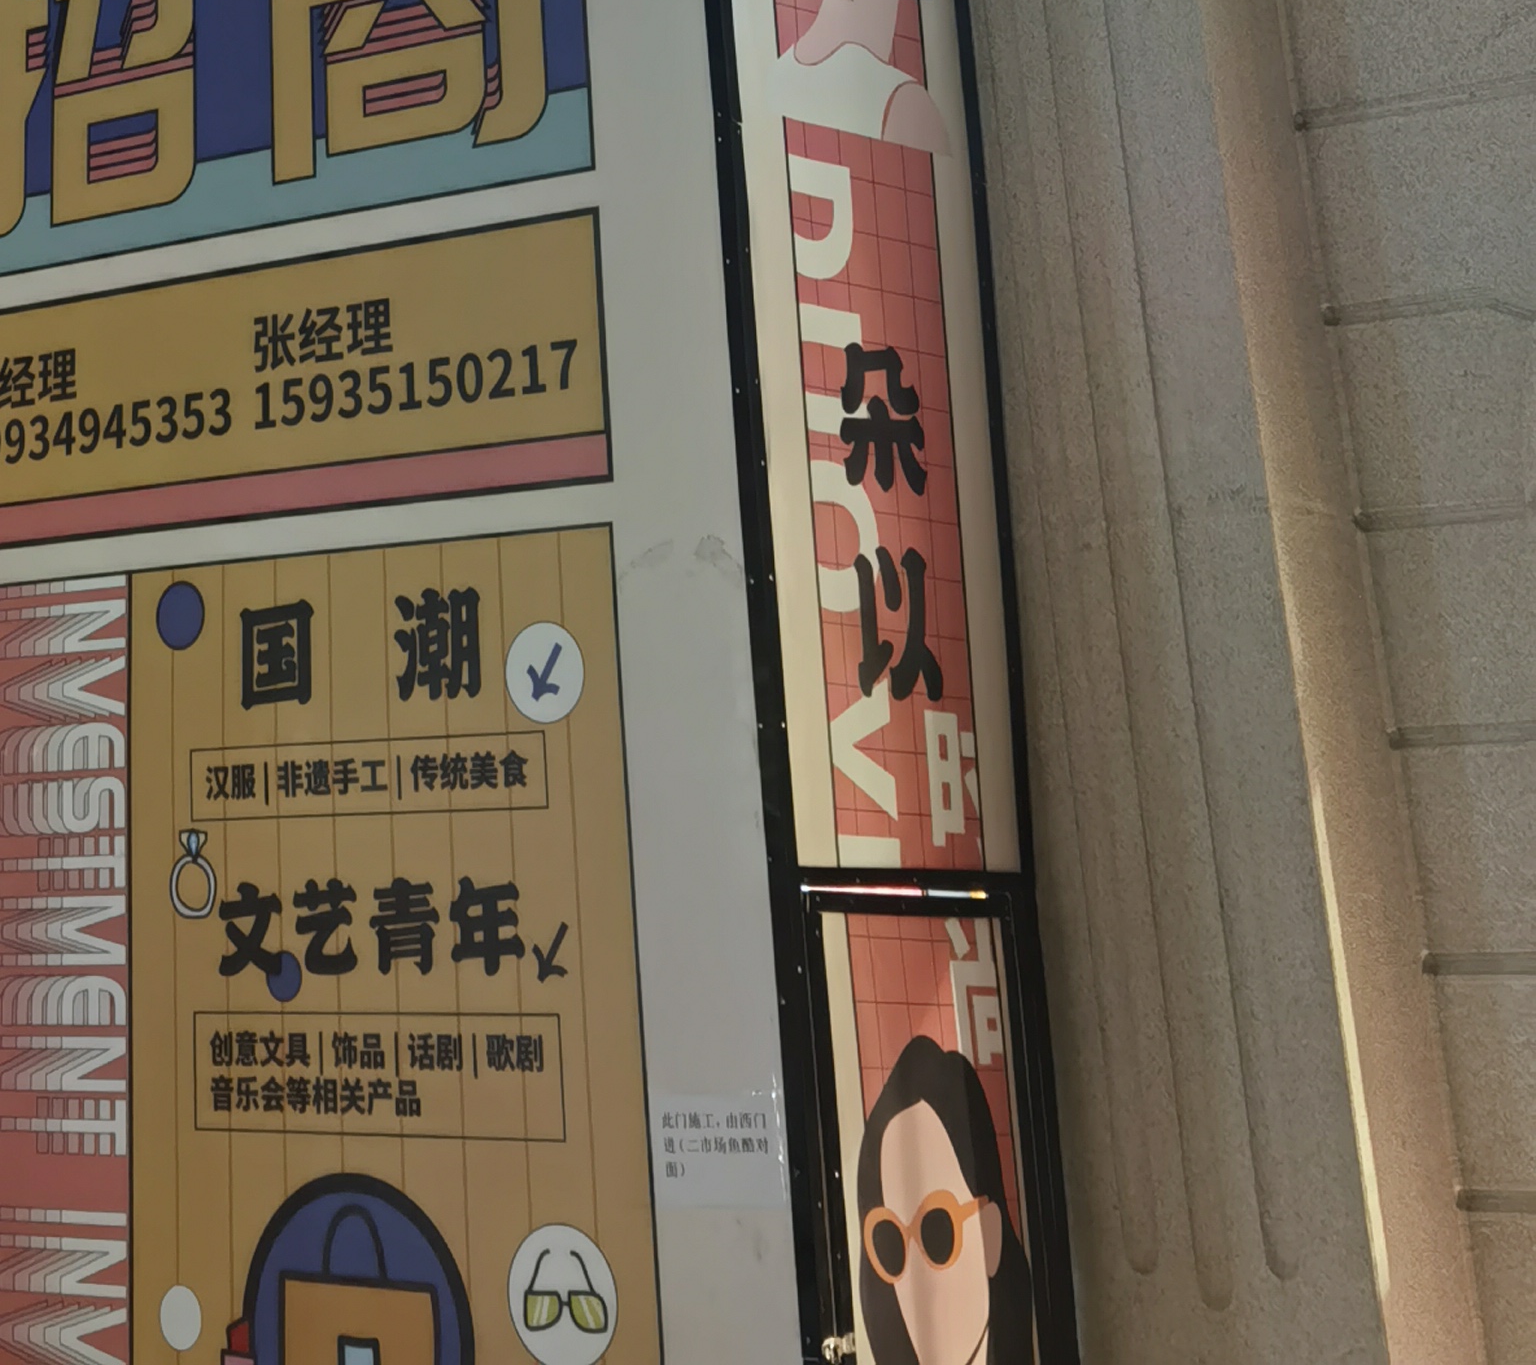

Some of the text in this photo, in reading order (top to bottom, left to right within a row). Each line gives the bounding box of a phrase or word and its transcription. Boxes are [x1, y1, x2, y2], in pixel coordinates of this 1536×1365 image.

[252, 297, 394, 374] 张经理
[253, 338, 578, 432] 15935150217
[205, 749, 529, 802] 汉服 非遗手工 传统美食
[24, 574, 127, 1157] INVESTMENT
[219, 876, 527, 976] 文艺青年
[210, 1030, 310, 1068] 创意文具
[210, 1075, 422, 1118] 音乐会等相关产品
